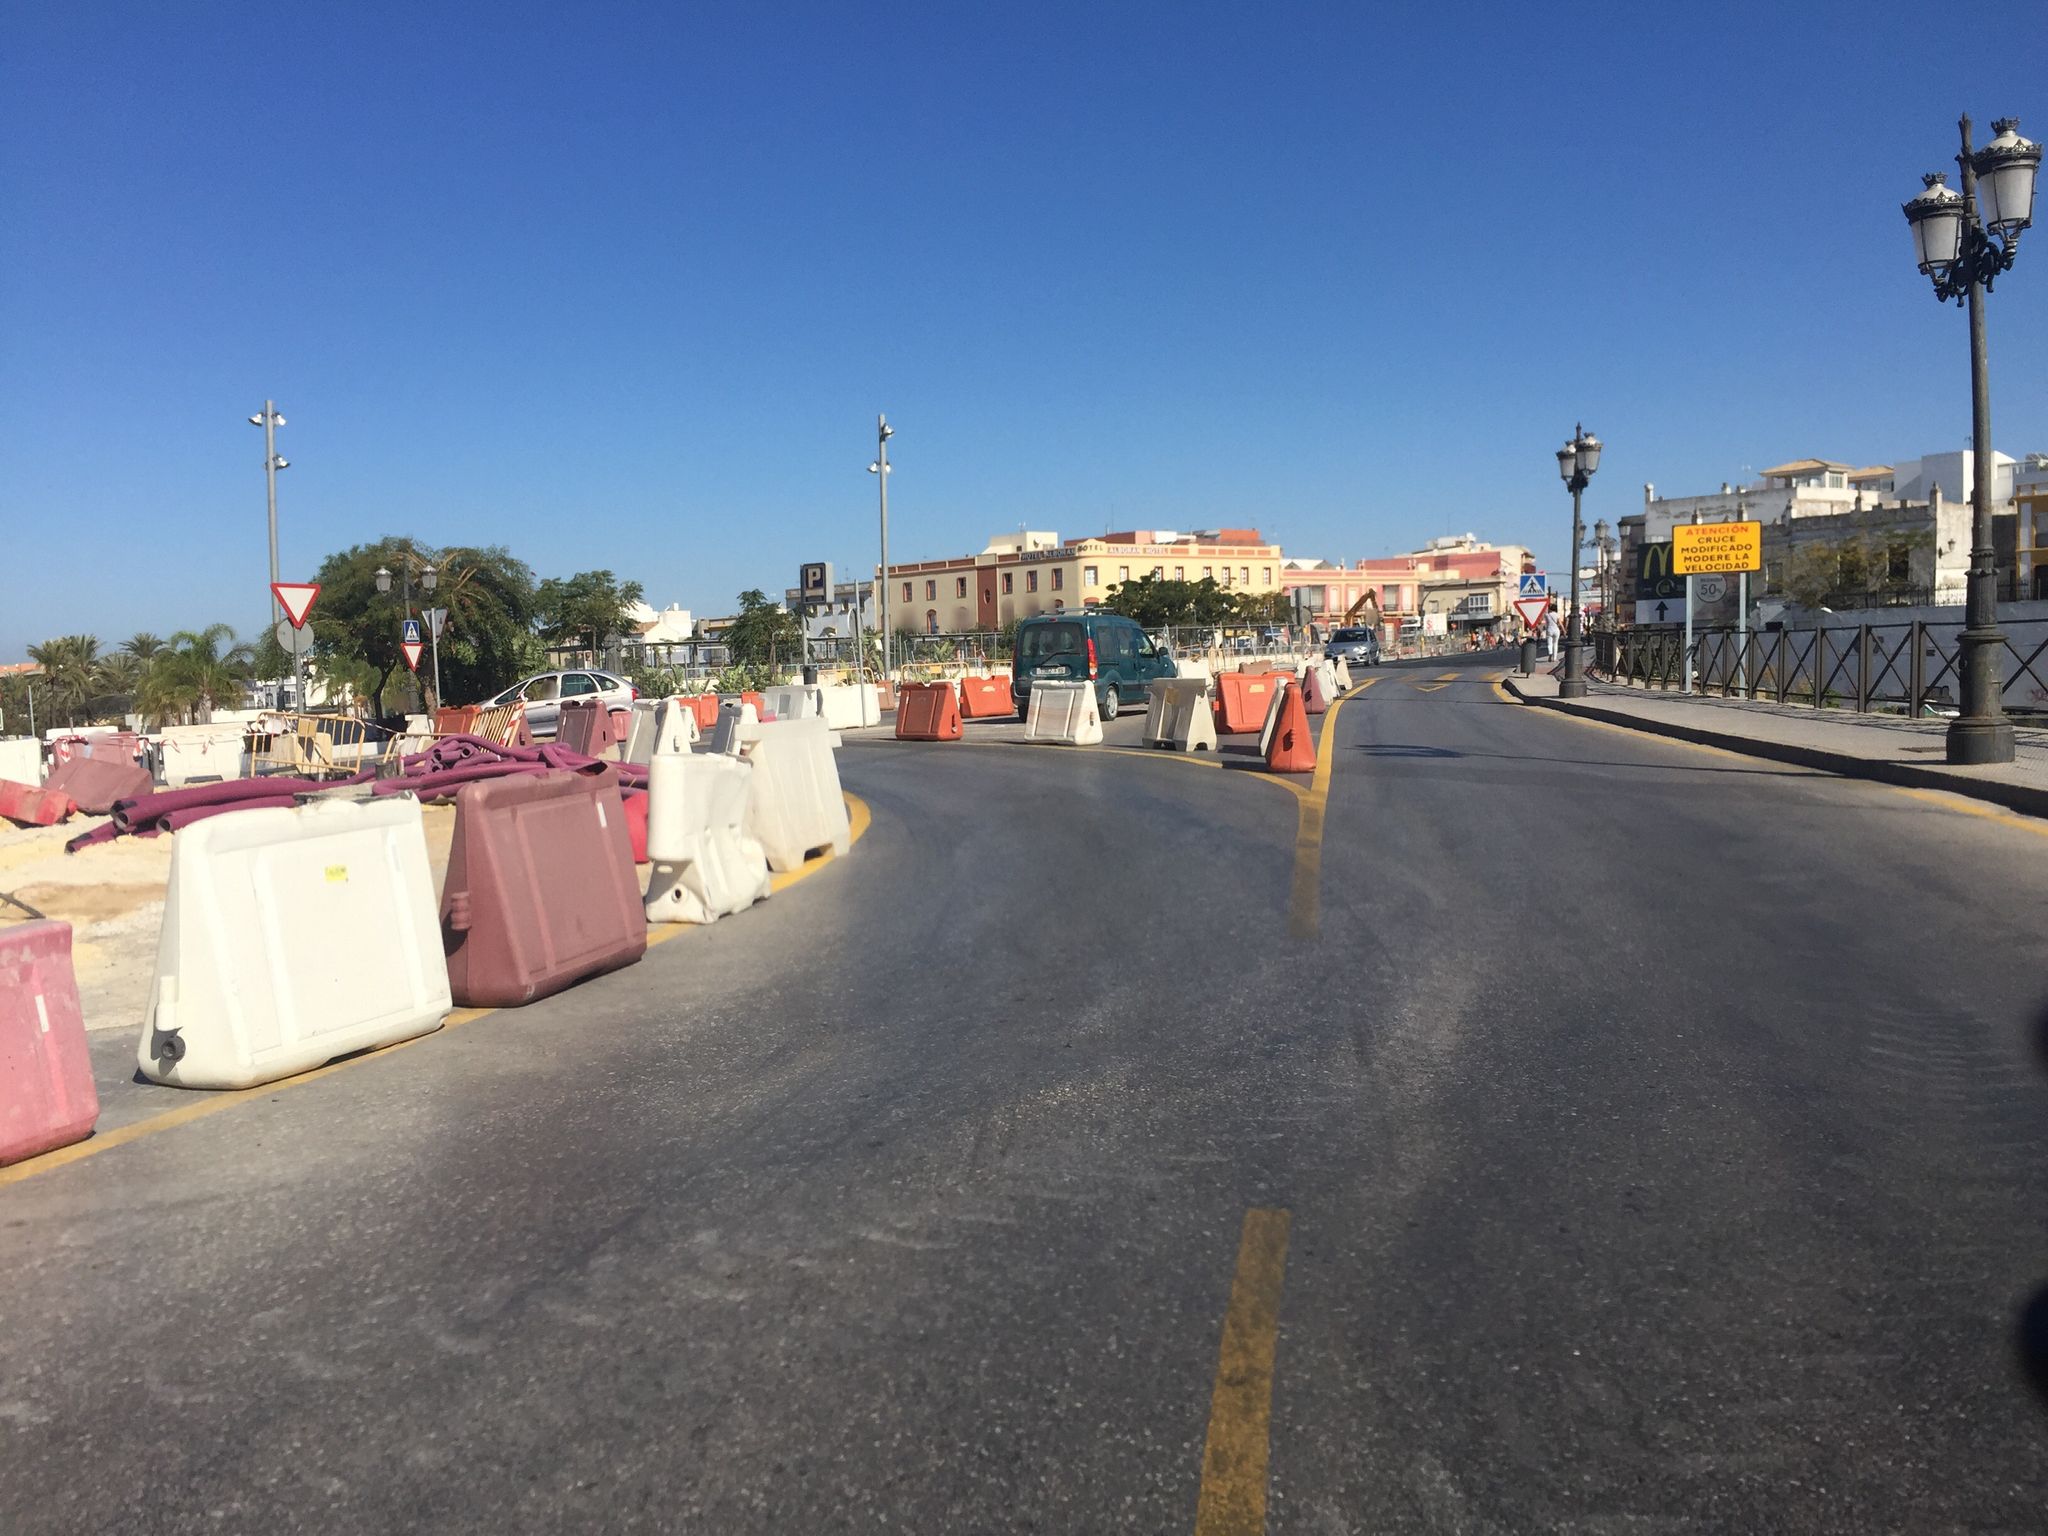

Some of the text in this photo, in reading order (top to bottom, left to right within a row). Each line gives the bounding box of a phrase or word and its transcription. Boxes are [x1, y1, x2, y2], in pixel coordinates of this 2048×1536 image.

[1686, 525, 1749, 536] ATENCIÓN
[1697, 535, 1736, 544] CRUCE
[1681, 543, 1753, 554] MODIFICADO
[1683, 552, 1749, 563] MODERE LA
[1685, 561, 1749, 572] VELOCIDAD
[808, 567, 821, 588] P
